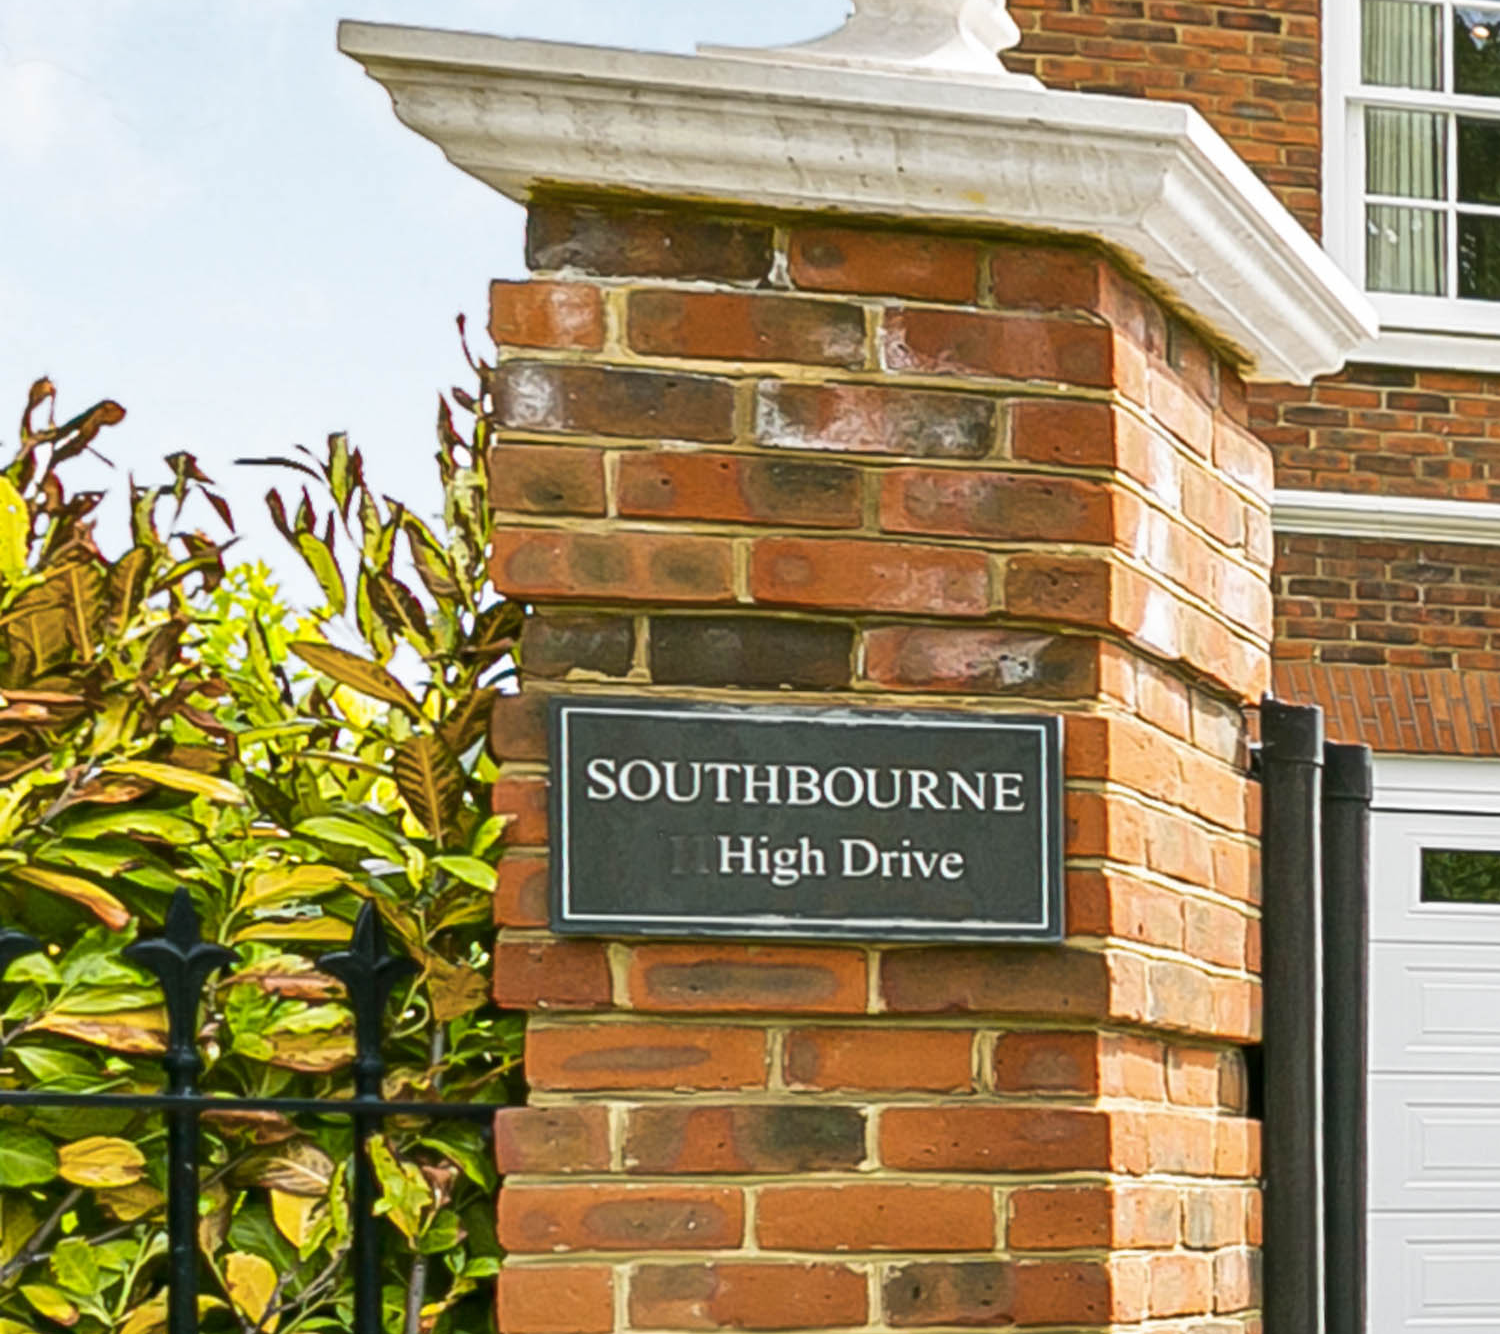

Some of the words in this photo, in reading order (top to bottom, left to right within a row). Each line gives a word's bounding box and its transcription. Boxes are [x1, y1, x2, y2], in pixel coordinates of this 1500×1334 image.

[586, 758, 1026, 812] SOUTHBOURNE
[718, 835, 826, 886] High
[840, 838, 965, 880] Drive
